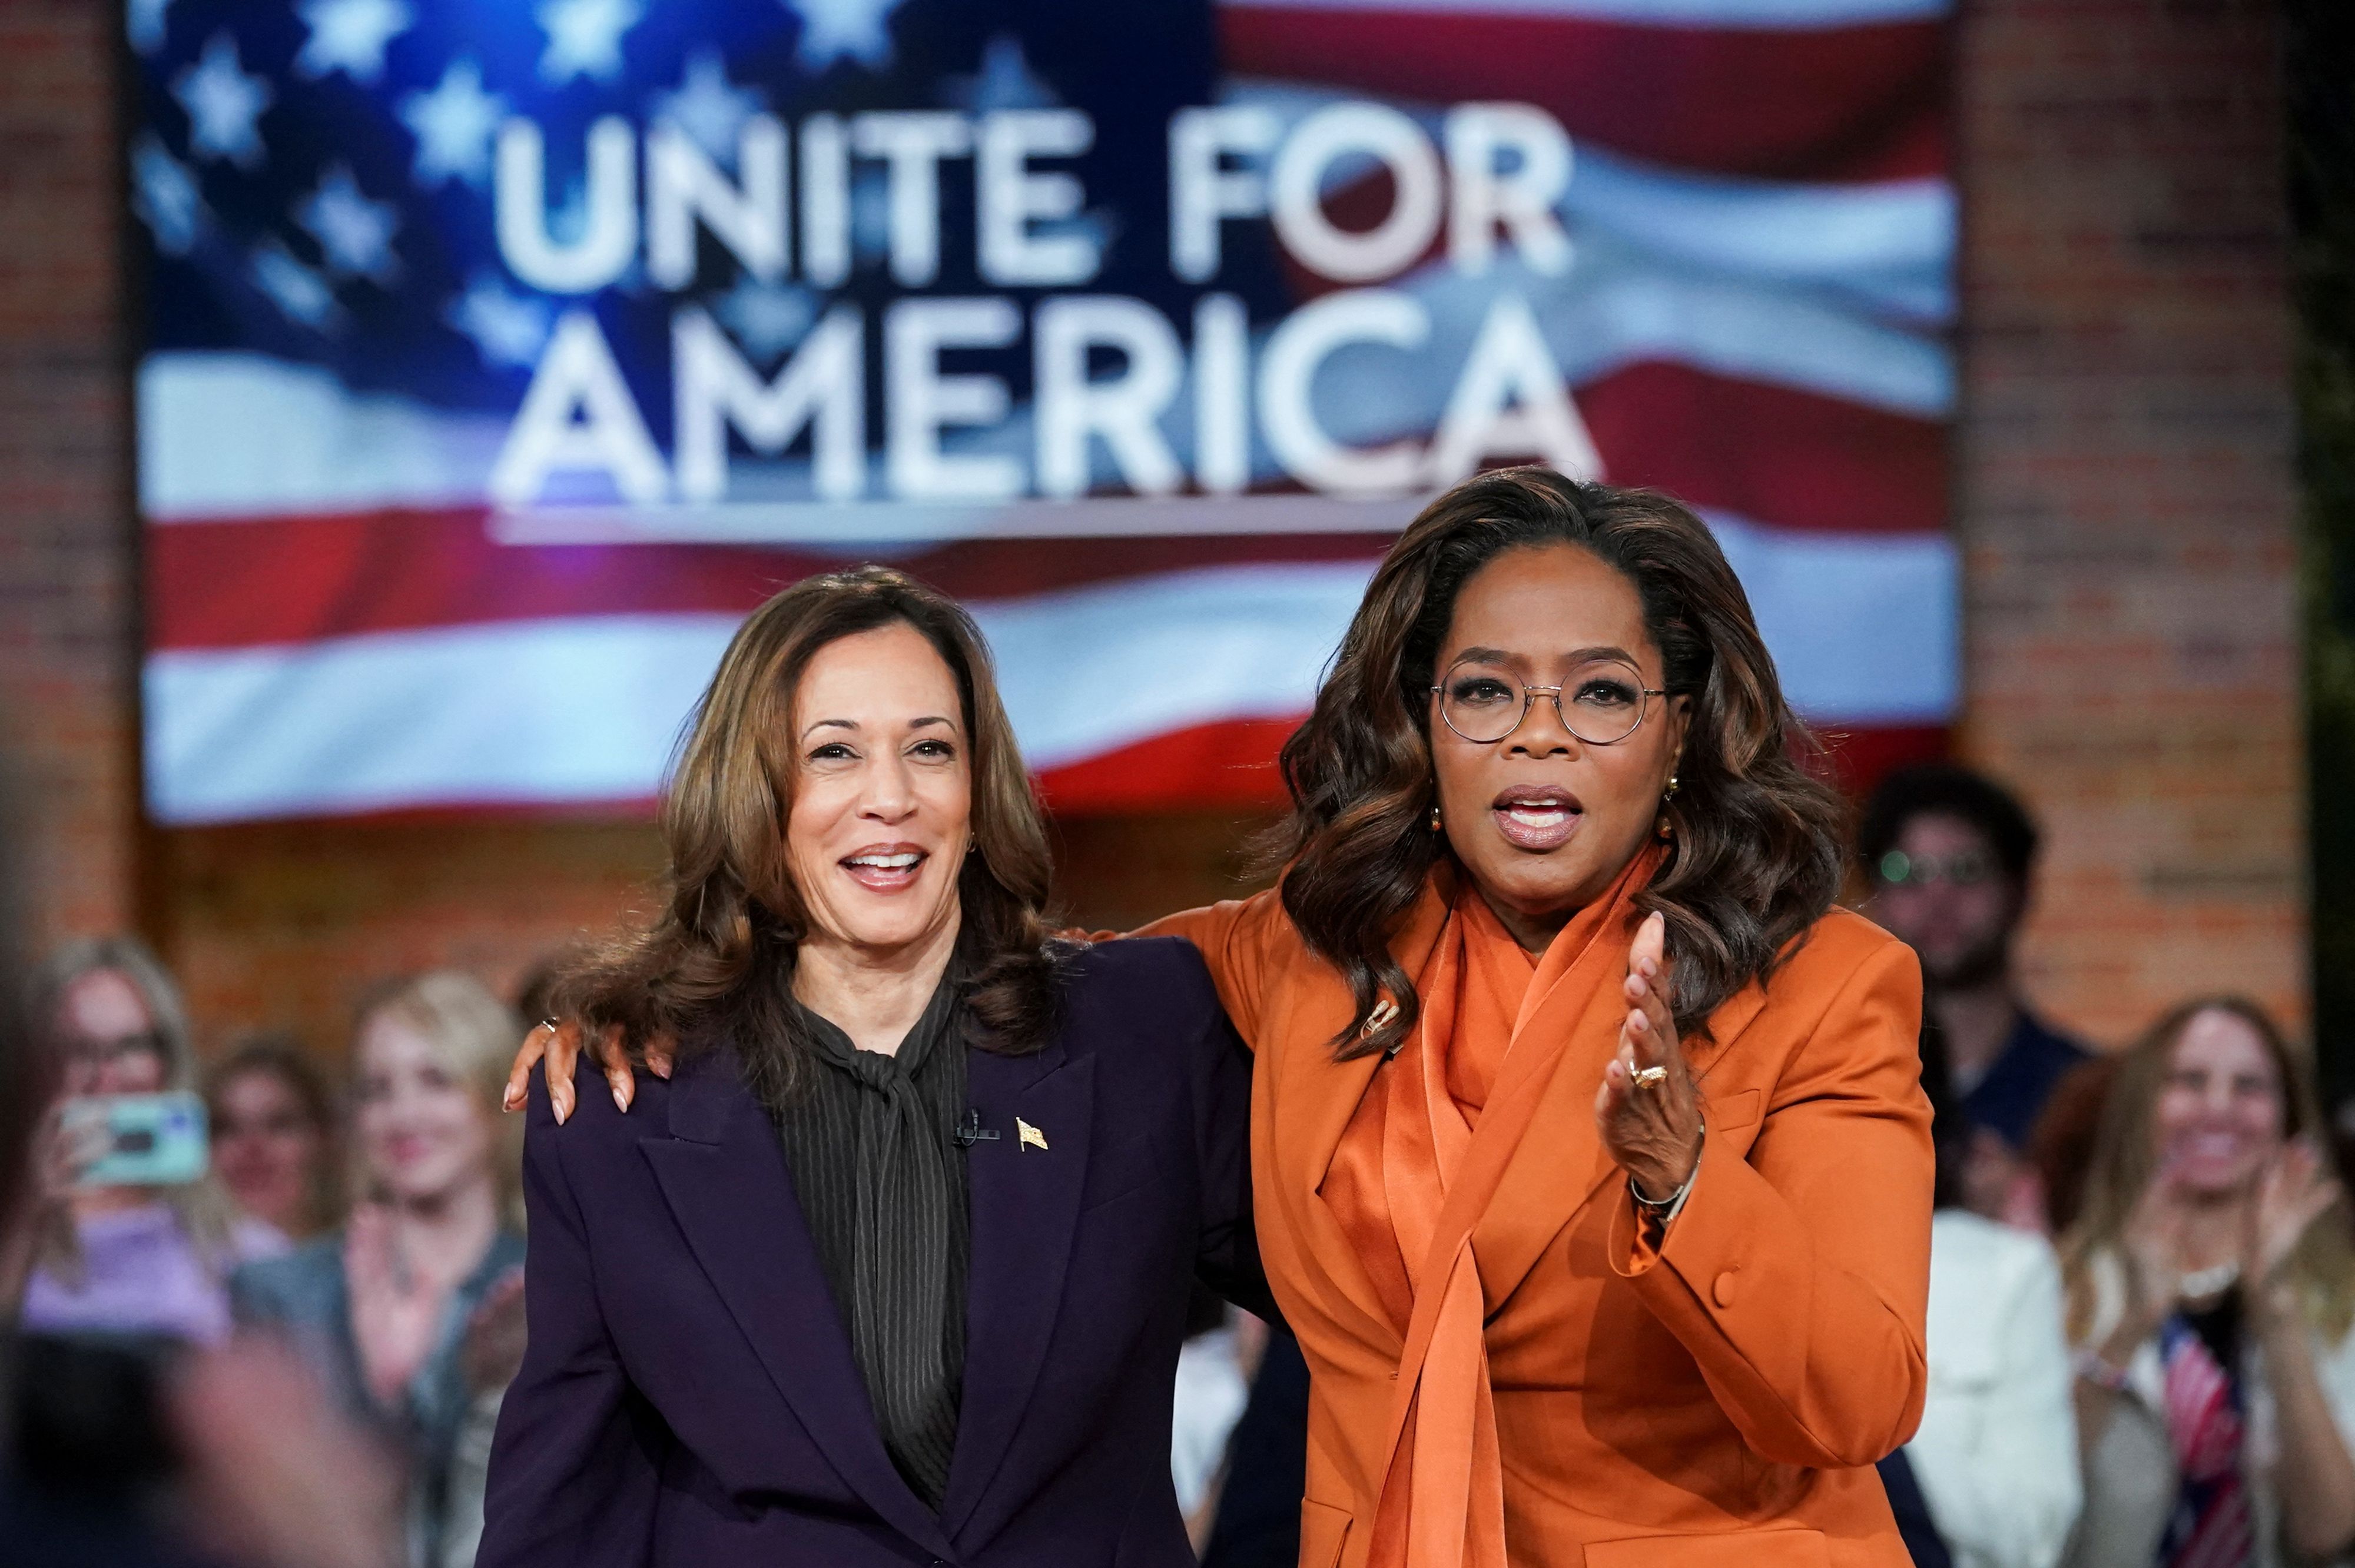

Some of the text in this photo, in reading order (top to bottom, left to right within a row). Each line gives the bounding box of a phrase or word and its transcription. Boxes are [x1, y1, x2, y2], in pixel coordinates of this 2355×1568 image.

[495, 100, 1575, 293] UNITE FOR
[490, 293, 1603, 504] AMERICA
